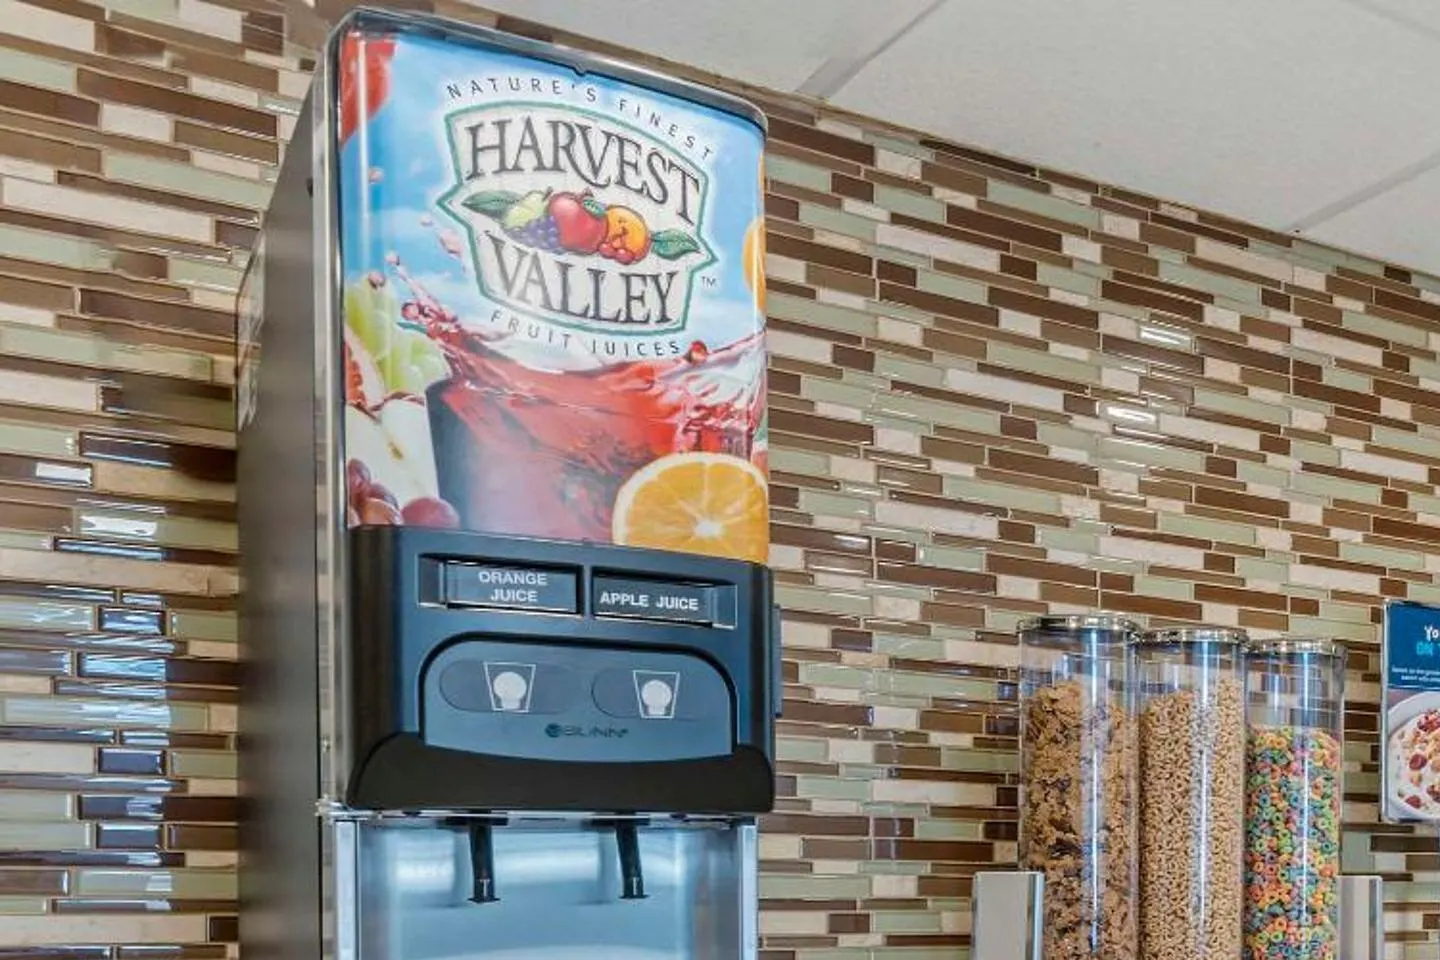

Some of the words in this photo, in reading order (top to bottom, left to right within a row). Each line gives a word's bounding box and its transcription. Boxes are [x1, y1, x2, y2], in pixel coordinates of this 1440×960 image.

[447, 77, 597, 102] NATURE'S
[618, 98, 713, 160] FINEST
[464, 115, 700, 224] HARVEST
[482, 230, 679, 325] VALLEY
[490, 309, 573, 347] FRUIT
[591, 340, 681, 356] JUICES
[478, 571, 548, 586] ORANGE
[490, 589, 539, 603] JUICE
[600, 592, 649, 608] APPLE
[656, 596, 699, 611] JUICE
[1416, 643, 1434, 657] ON
